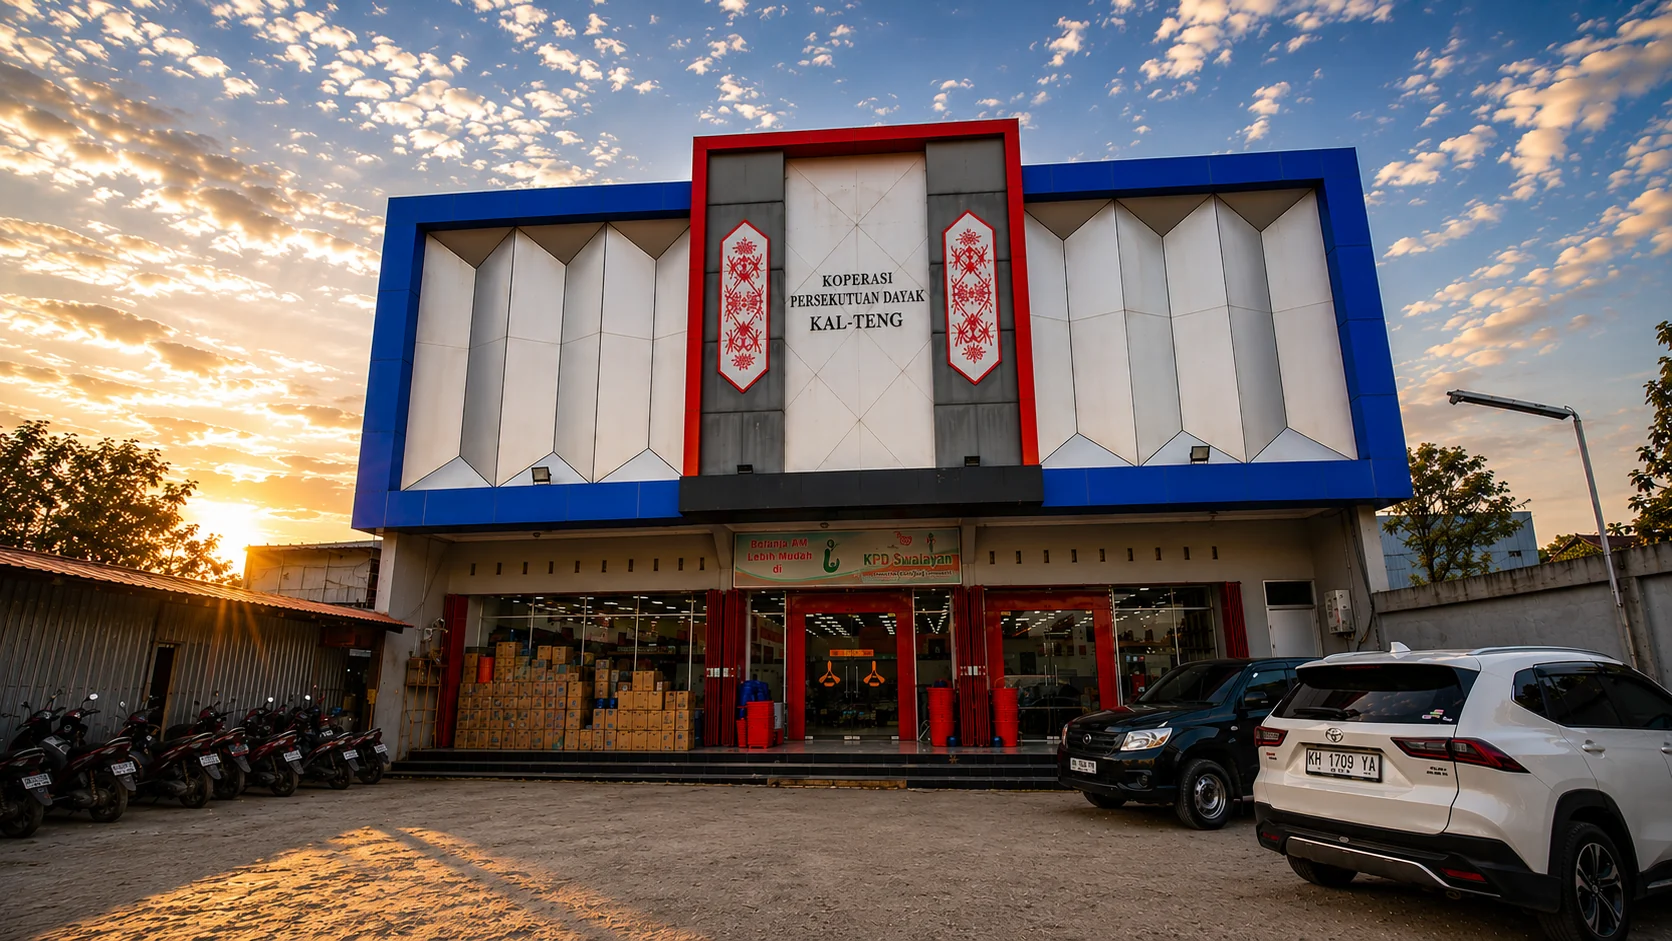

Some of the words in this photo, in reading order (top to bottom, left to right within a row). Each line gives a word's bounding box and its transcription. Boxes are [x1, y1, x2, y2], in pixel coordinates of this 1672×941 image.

[822, 272, 893, 287] KOPERASI
[790, 291, 879, 308] PERSEKUTUAN
[883, 289, 925, 304] DAYAK
[810, 312, 904, 331] KAL-TENG
[747, 552, 775, 561] Lebih
[778, 551, 812, 560] Mudah
[863, 553, 889, 566] KPD
[893, 552, 952, 568] Swalayan
[772, 564, 782, 574] di
[1308, 751, 1322, 766] KH
[1328, 753, 1354, 769] 1709
[1361, 755, 1376, 772] YA
